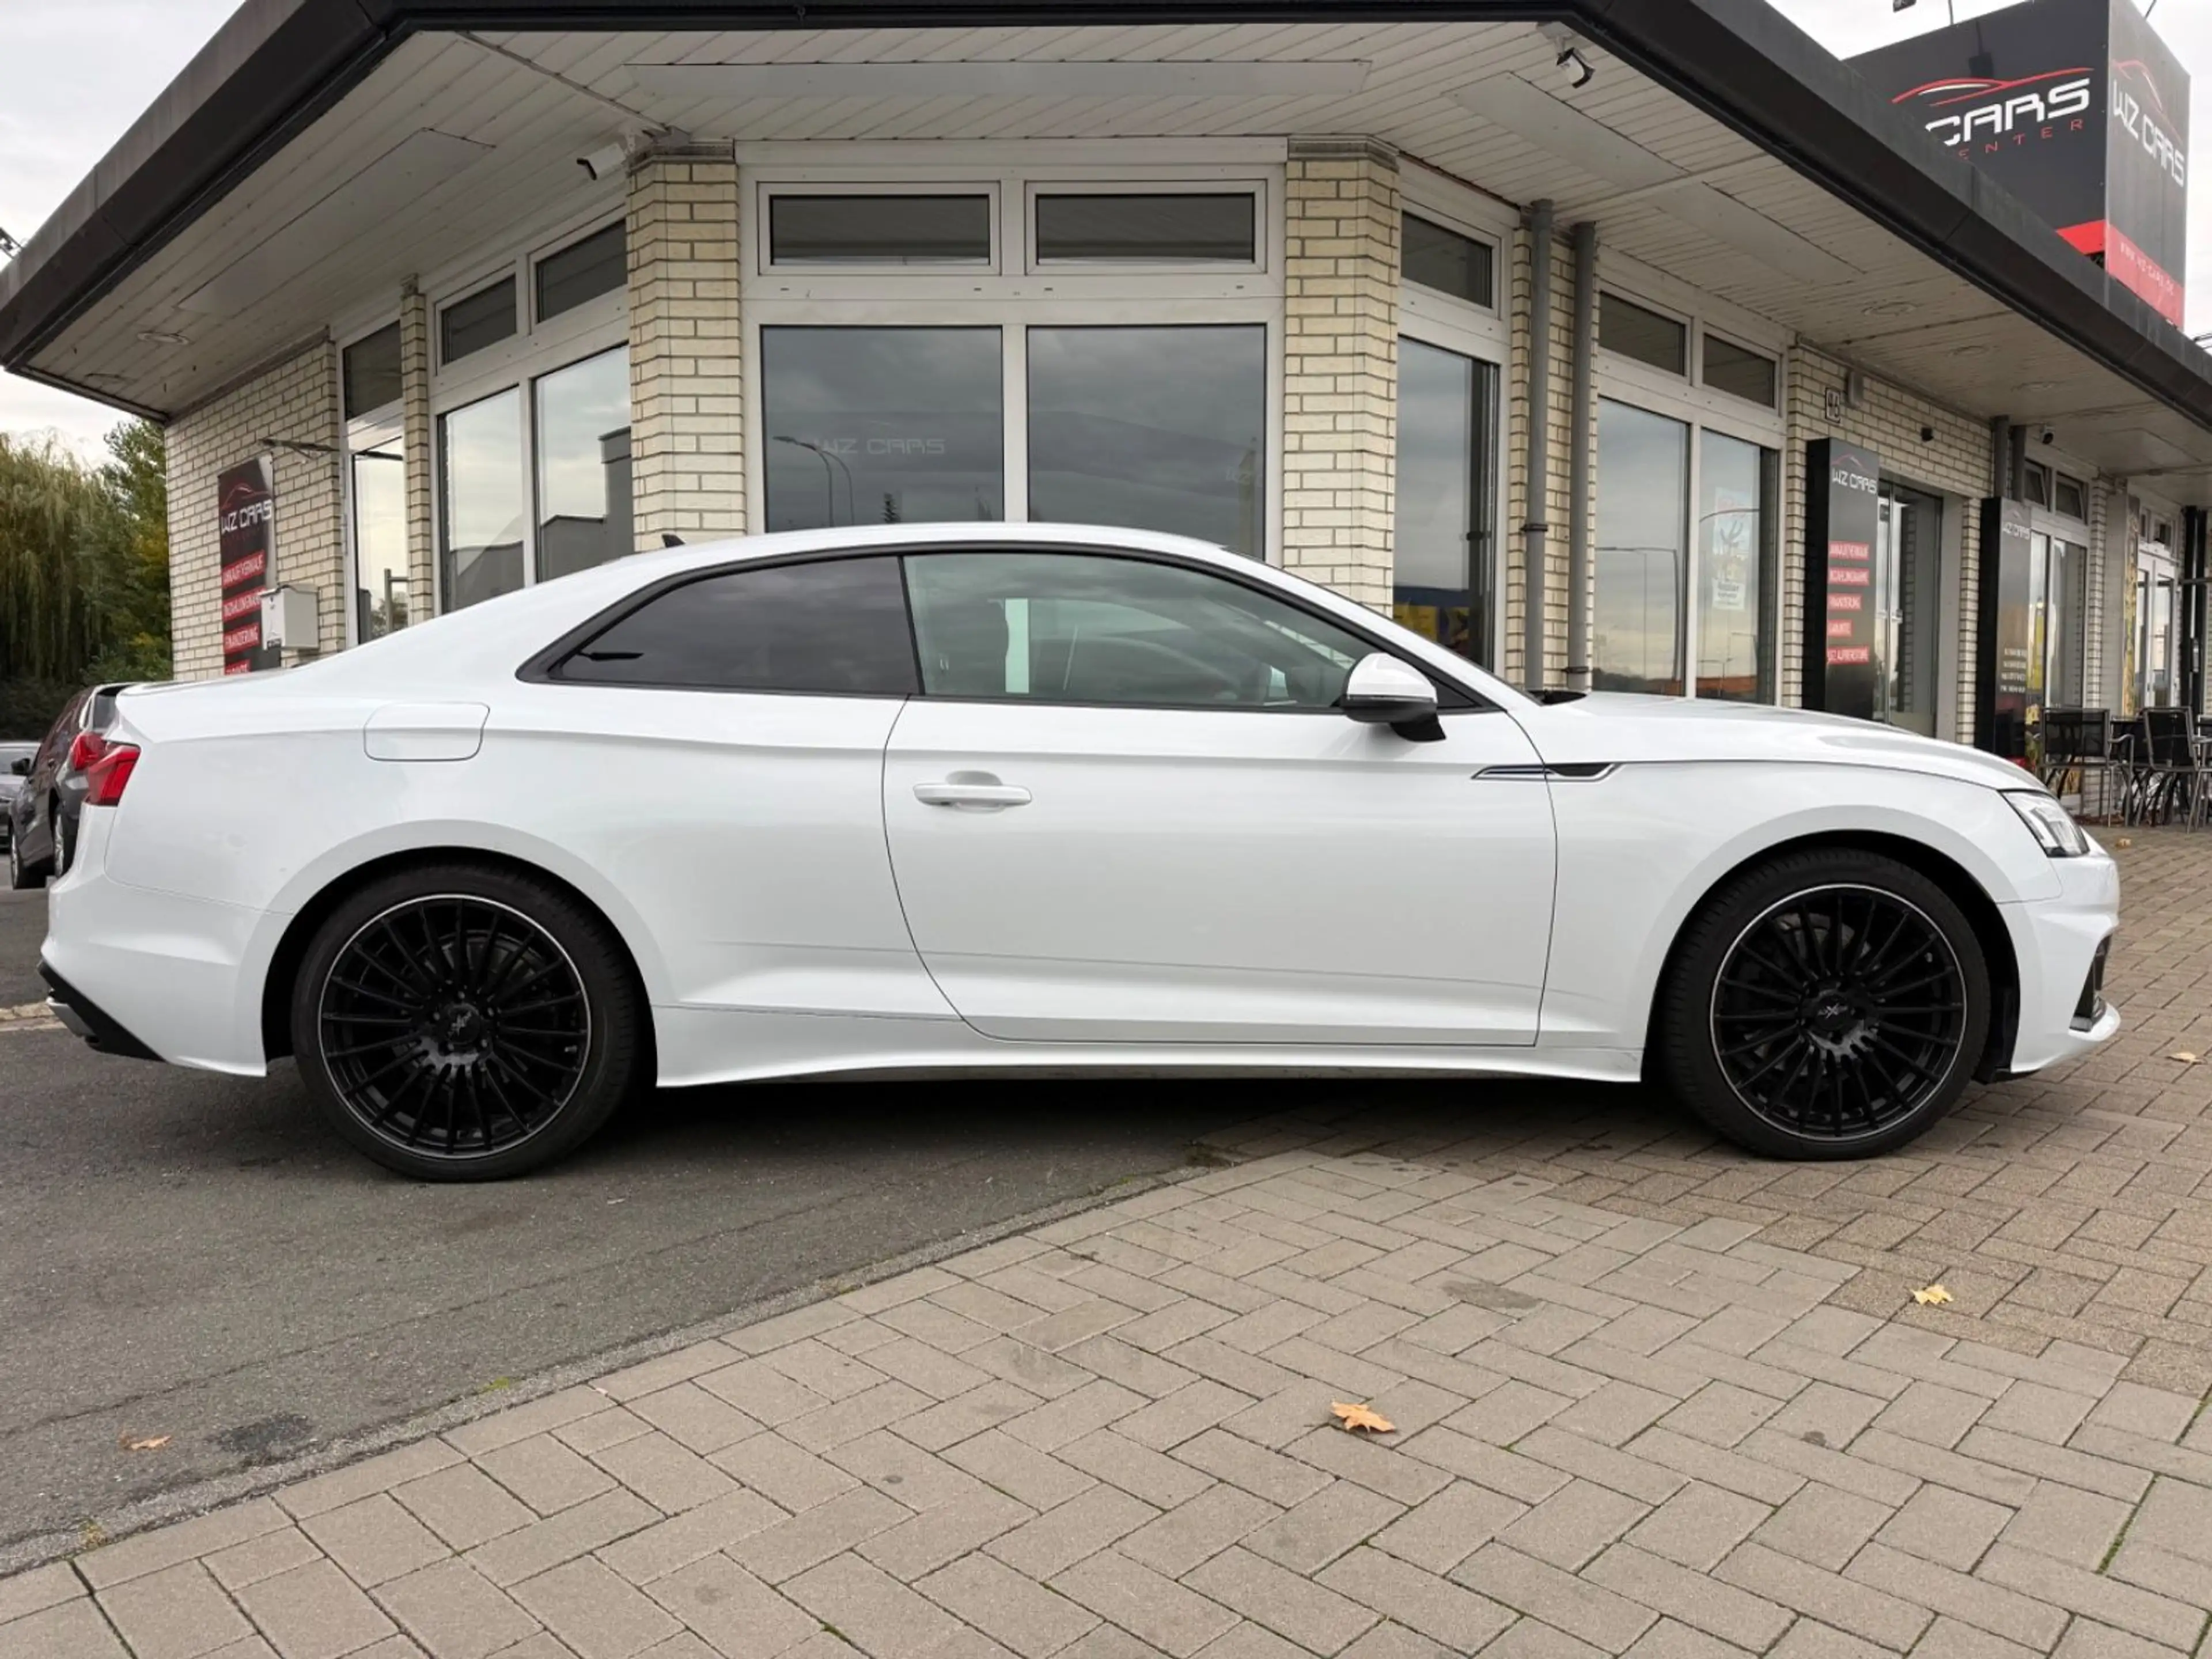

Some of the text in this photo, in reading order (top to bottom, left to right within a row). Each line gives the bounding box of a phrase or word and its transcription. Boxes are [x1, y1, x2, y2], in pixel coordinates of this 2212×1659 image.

[1925, 78, 2090, 146] CARS
[1958, 119, 2084, 160] ENTER
[2113, 78, 2185, 188] WZ CARS
[866, 438, 946, 455] CARS
[1832, 468, 1877, 495] WZ CARS
[221, 498, 272, 535] WZ CARS
